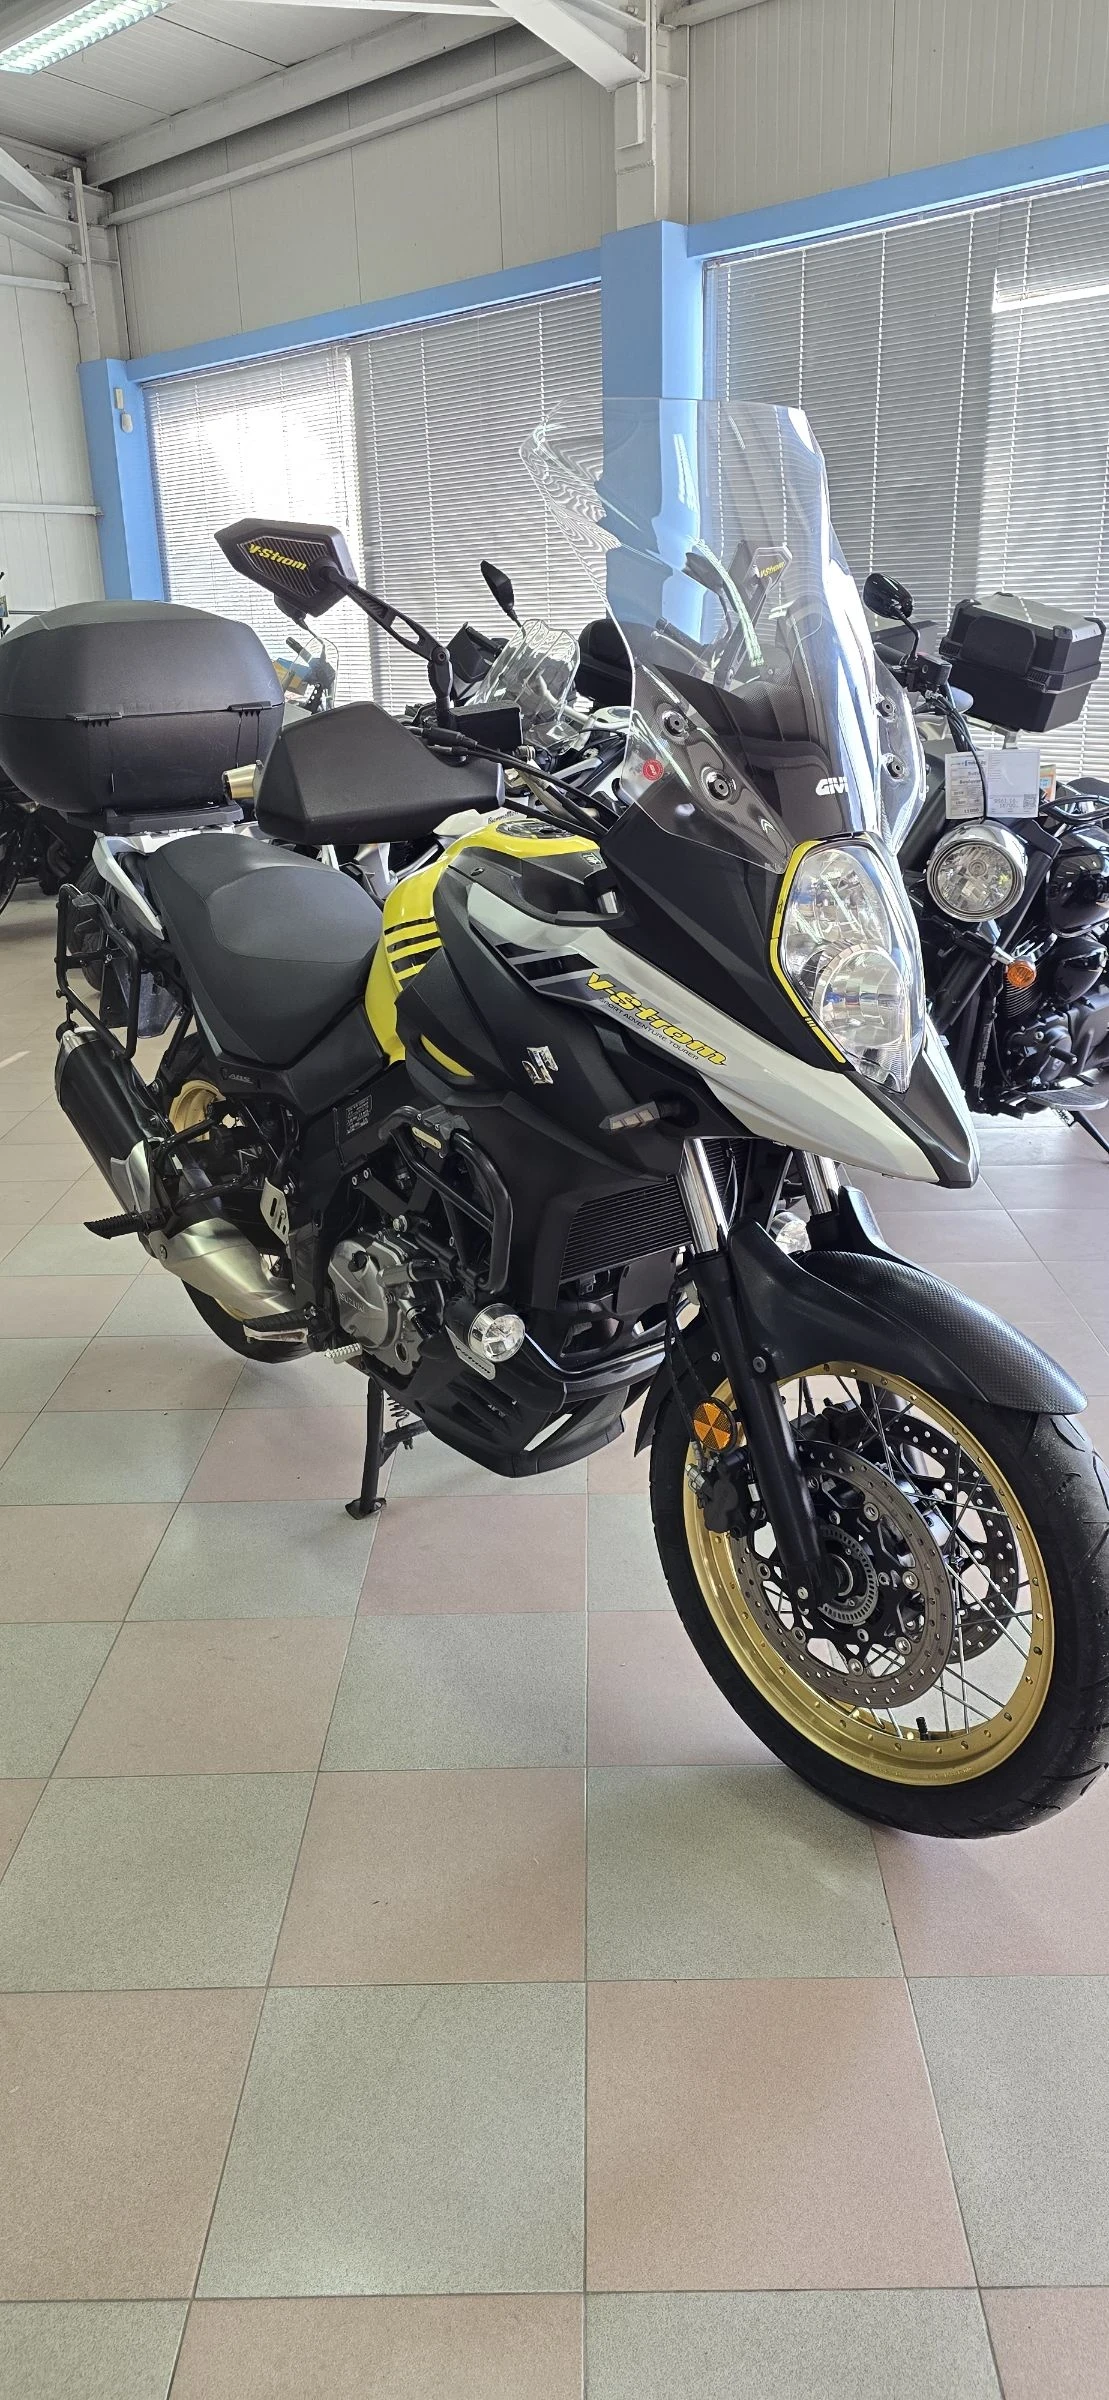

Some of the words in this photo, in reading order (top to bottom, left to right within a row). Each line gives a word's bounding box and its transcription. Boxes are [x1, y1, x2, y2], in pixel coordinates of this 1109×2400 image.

[249, 543, 307, 570] V-Strom
[587, 972, 727, 1066] V-Strom
[599, 998, 624, 1017] SPORT
[624, 1012, 667, 1042] ADVENTURE
[668, 1040, 699, 1061] TOURER
